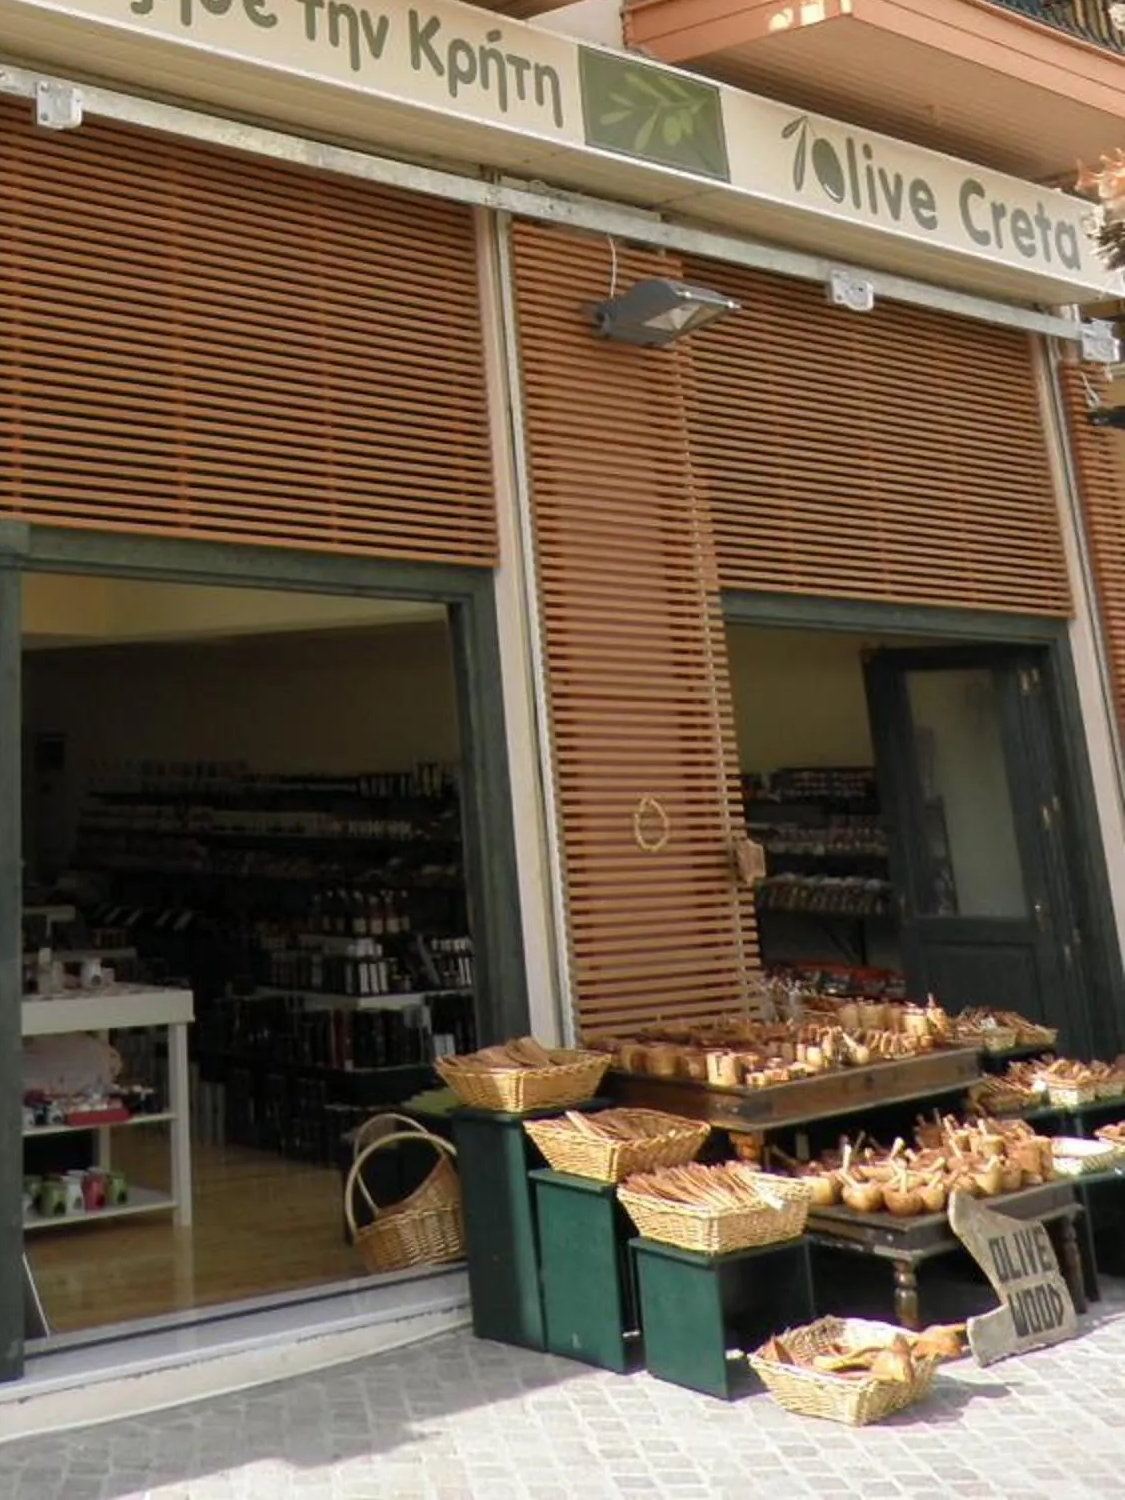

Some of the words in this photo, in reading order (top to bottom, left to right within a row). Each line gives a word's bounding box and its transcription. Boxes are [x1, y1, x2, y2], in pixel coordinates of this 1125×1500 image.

[408, 8, 565, 129] Κρήτη
[957, 177, 1082, 271] Creta
[989, 1226, 1053, 1282] OLIVE
[1008, 1284, 1064, 1337] WOOD
